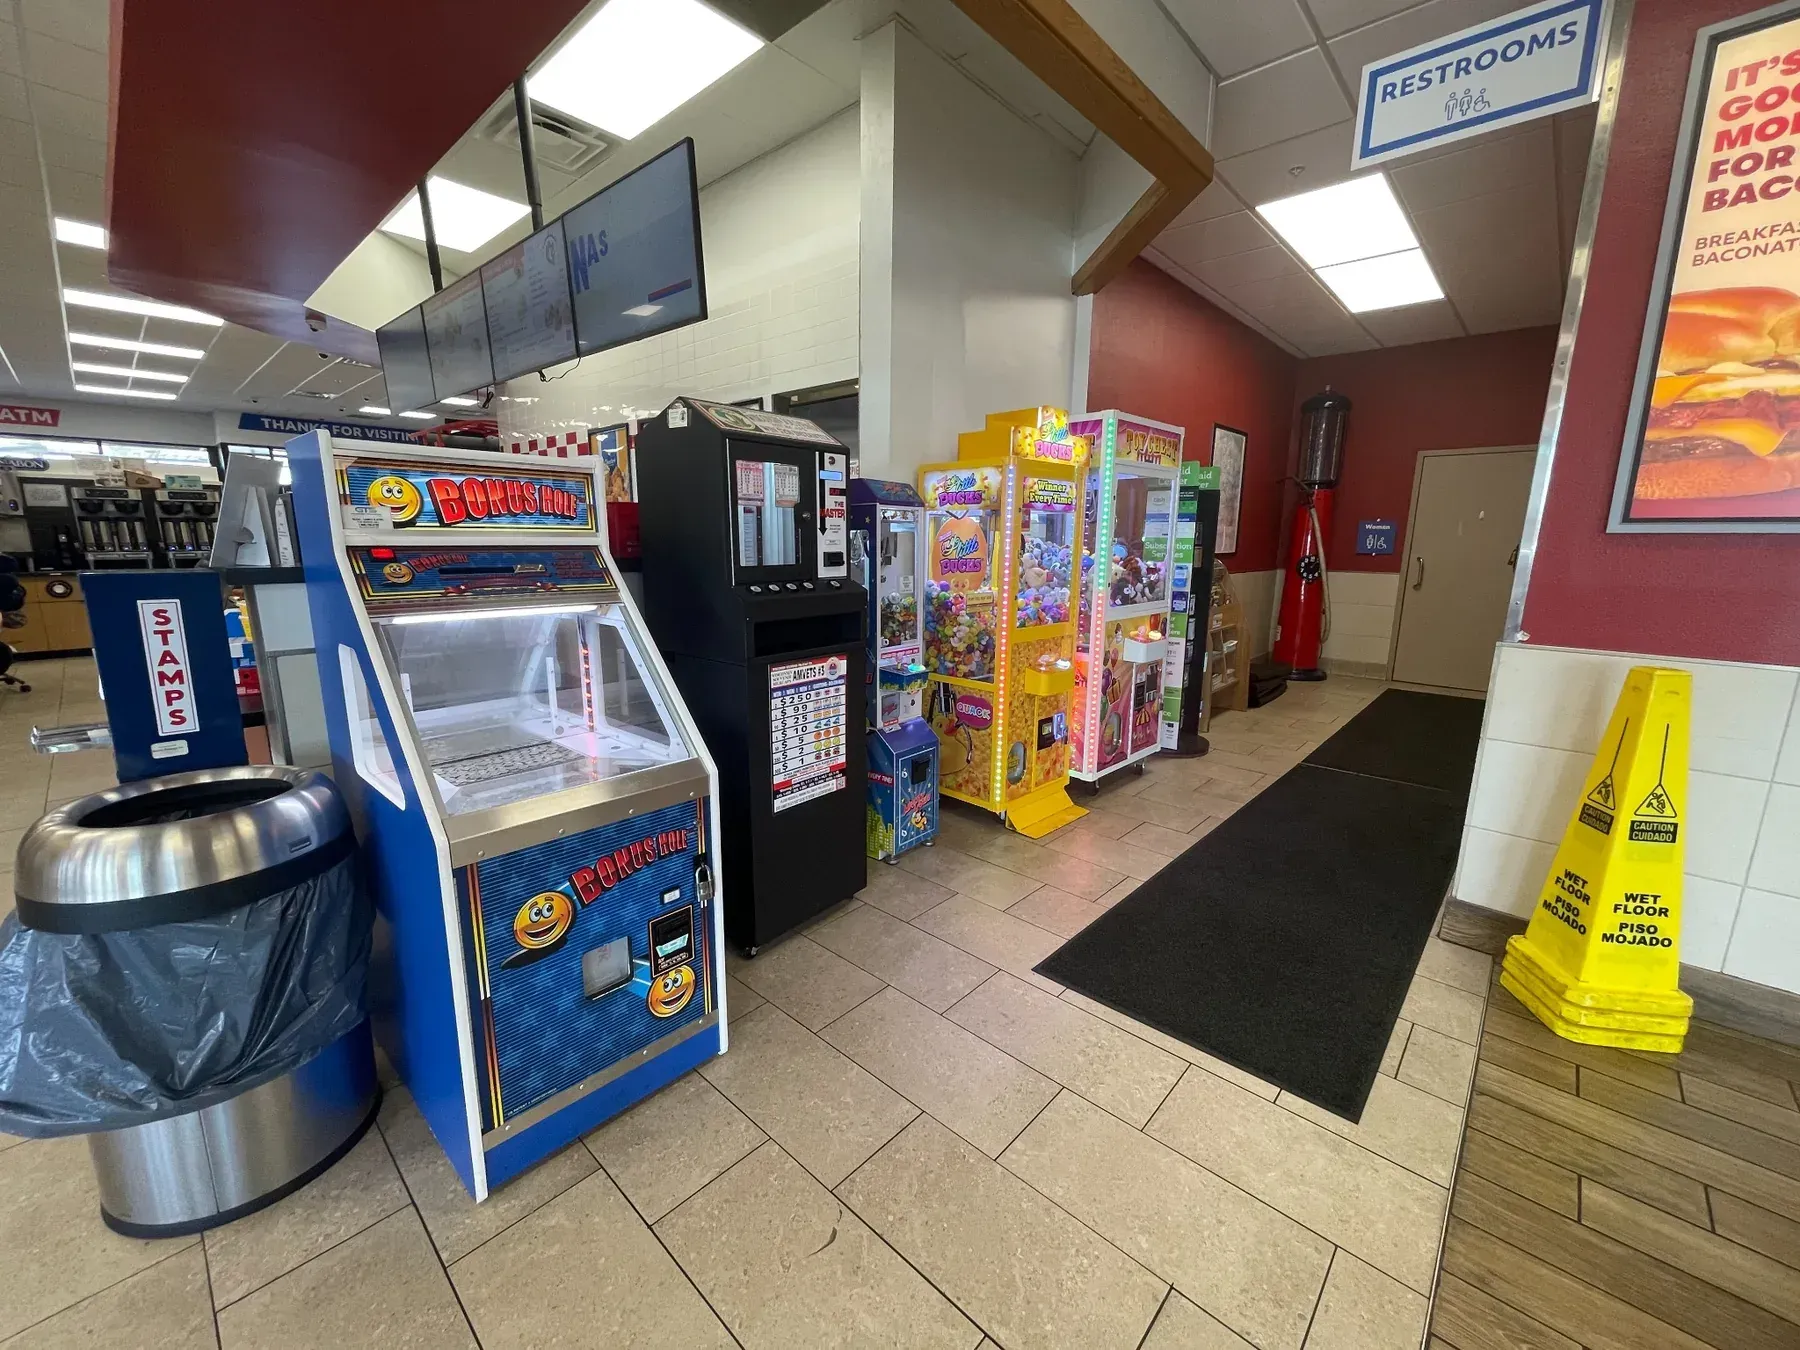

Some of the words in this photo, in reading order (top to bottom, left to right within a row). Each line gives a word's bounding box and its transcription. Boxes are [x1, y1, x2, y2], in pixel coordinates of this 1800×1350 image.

[1381, 20, 1578, 103] RESTROOMS
[1725, 49, 1800, 92] IT'S
[1707, 144, 1796, 184] FOR
[1702, 175, 1800, 213] BAC
[0, 408, 52, 425] ATM
[332, 425, 362, 438] FOR
[364, 428, 417, 442] VISITIN
[1035, 440, 1073, 461] DUCKS
[1037, 480, 1066, 492] Winner
[426, 476, 538, 526] BONUS
[539, 485, 579, 519] HOLE
[938, 490, 983, 507] DUCKS
[1029, 492, 1050, 505] Every
[1053, 494, 1073, 505] Time
[1145, 541, 1192, 550] Subsction
[940, 558, 982, 576] DUCKS
[152, 608, 187, 726] STAMPS
[793, 666, 817, 681] AMVETS
[793, 704, 807, 713] 99
[956, 702, 991, 720] QUACK
[793, 715, 807, 724] 25
[794, 726, 807, 734] 10
[1582, 805, 1613, 824] CAUTION
[1581, 814, 1609, 833] CUIDADO
[1633, 822, 1674, 832] CAUTION
[1632, 831, 1673, 842] CUIDADO
[571, 839, 657, 905] BONUS
[656, 828, 689, 857] HOLE
[1564, 869, 1588, 890] WET
[1554, 876, 1591, 906] FLOOR
[1624, 893, 1661, 905] WET
[1555, 895, 1580, 918] PISO
[1613, 904, 1669, 918] FLOOR
[1542, 900, 1587, 936] MOJADO
[1618, 922, 1658, 935] PISO
[1601, 933, 1673, 948] MOJADO
